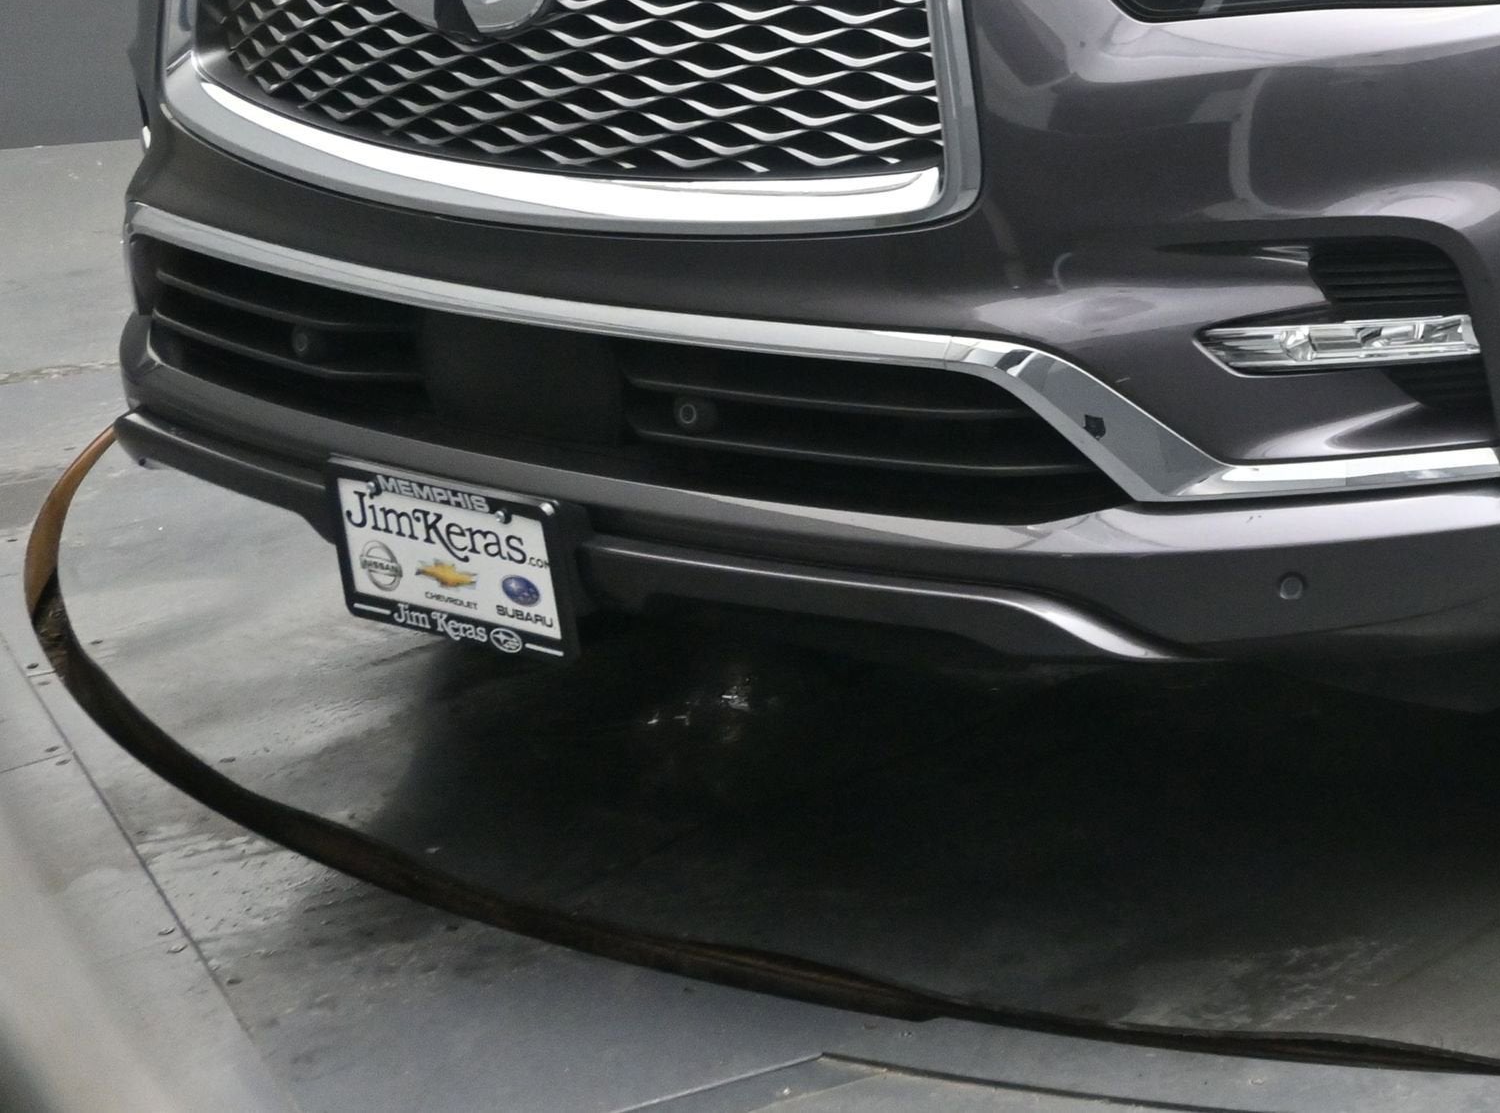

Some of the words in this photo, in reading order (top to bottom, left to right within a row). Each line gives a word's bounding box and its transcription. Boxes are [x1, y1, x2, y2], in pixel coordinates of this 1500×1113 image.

[375, 474, 490, 514] MEMPHIS
[424, 591, 479, 611] CHEVROLET
[495, 605, 554, 628] SUBARU
[393, 603, 430, 629] Jim
[431, 612, 488, 642] Keras
